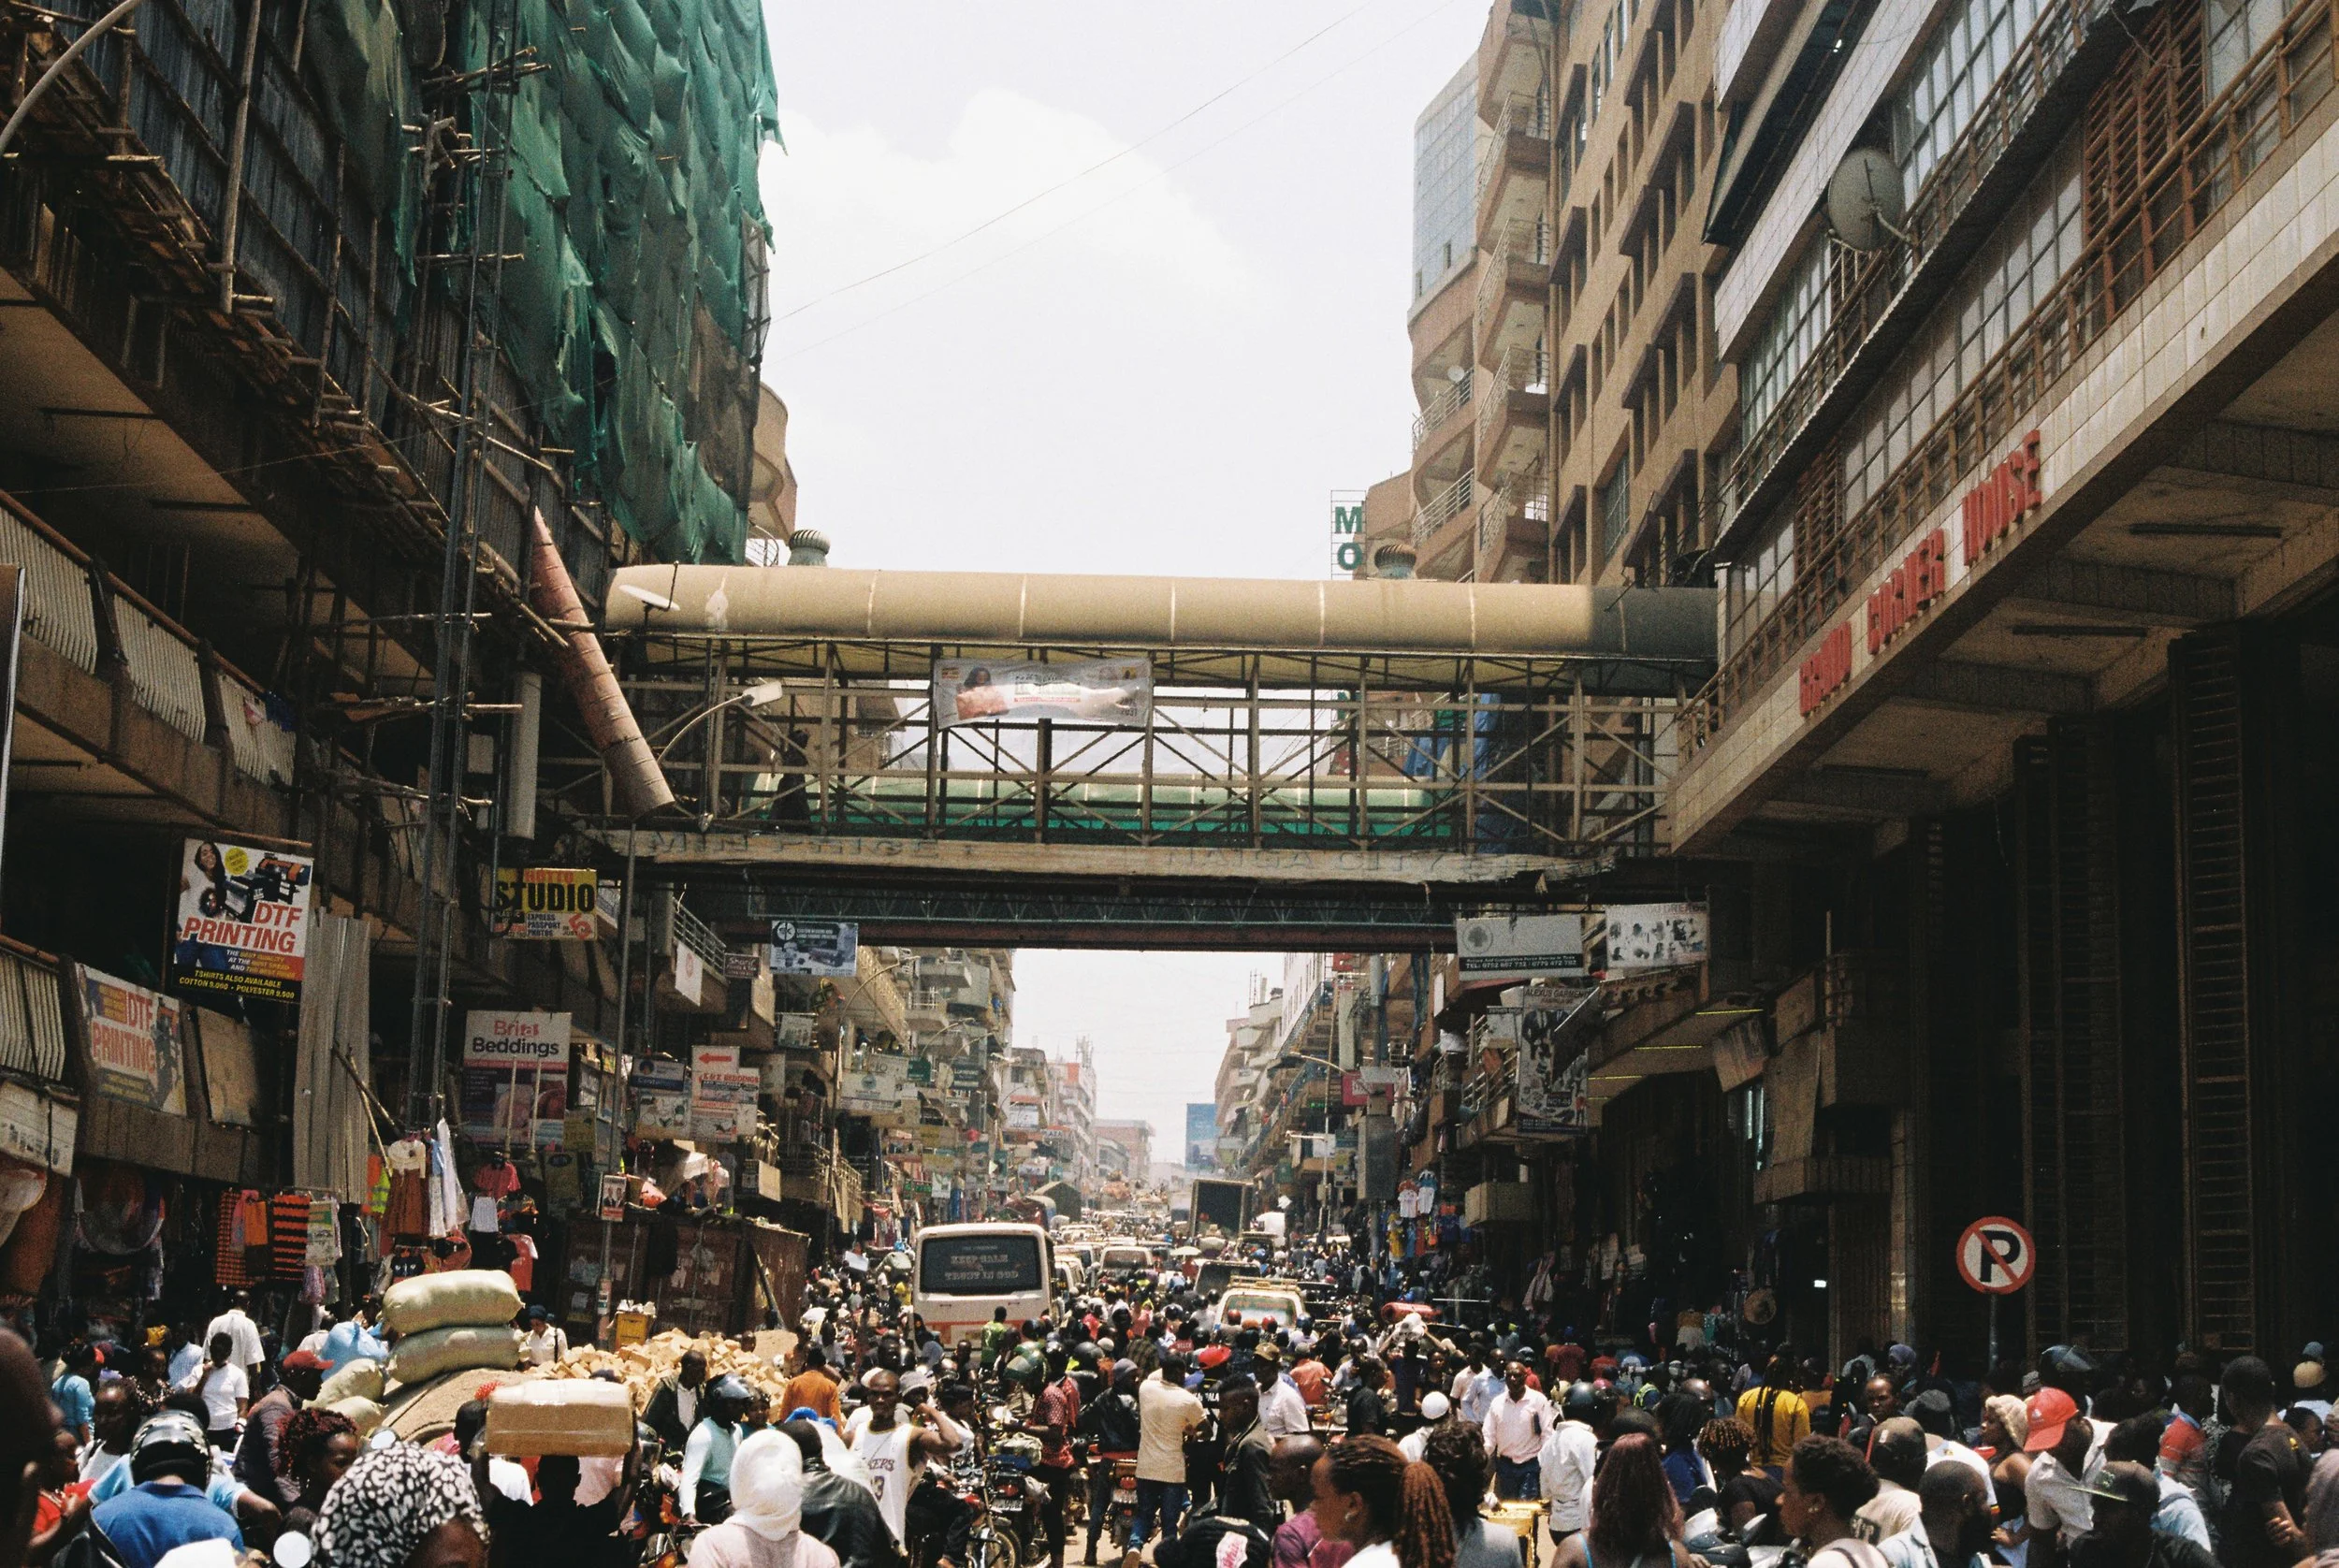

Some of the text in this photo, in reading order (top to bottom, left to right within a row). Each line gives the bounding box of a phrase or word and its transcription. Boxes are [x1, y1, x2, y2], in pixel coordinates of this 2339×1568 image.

[1867, 527, 1945, 656] CORNER
[1961, 428, 2042, 568] HOUSE
[496, 882, 595, 912] STUDIO
[253, 901, 302, 928] DTF
[182, 917, 297, 953] PRINTING
[226, 949, 240, 957] THE
[195, 970, 283, 989] TSHIRTS ALSO AVAILABLE
[231, 964, 245, 972] AND
[179, 977, 209, 988] COTTON
[236, 984, 275, 997] POLYESTER
[128, 993, 153, 1031] DTF
[92, 1021, 157, 1074] PRINTING
[472, 1037, 559, 1057] Beddings
[1980, 1230, 2021, 1283] P
